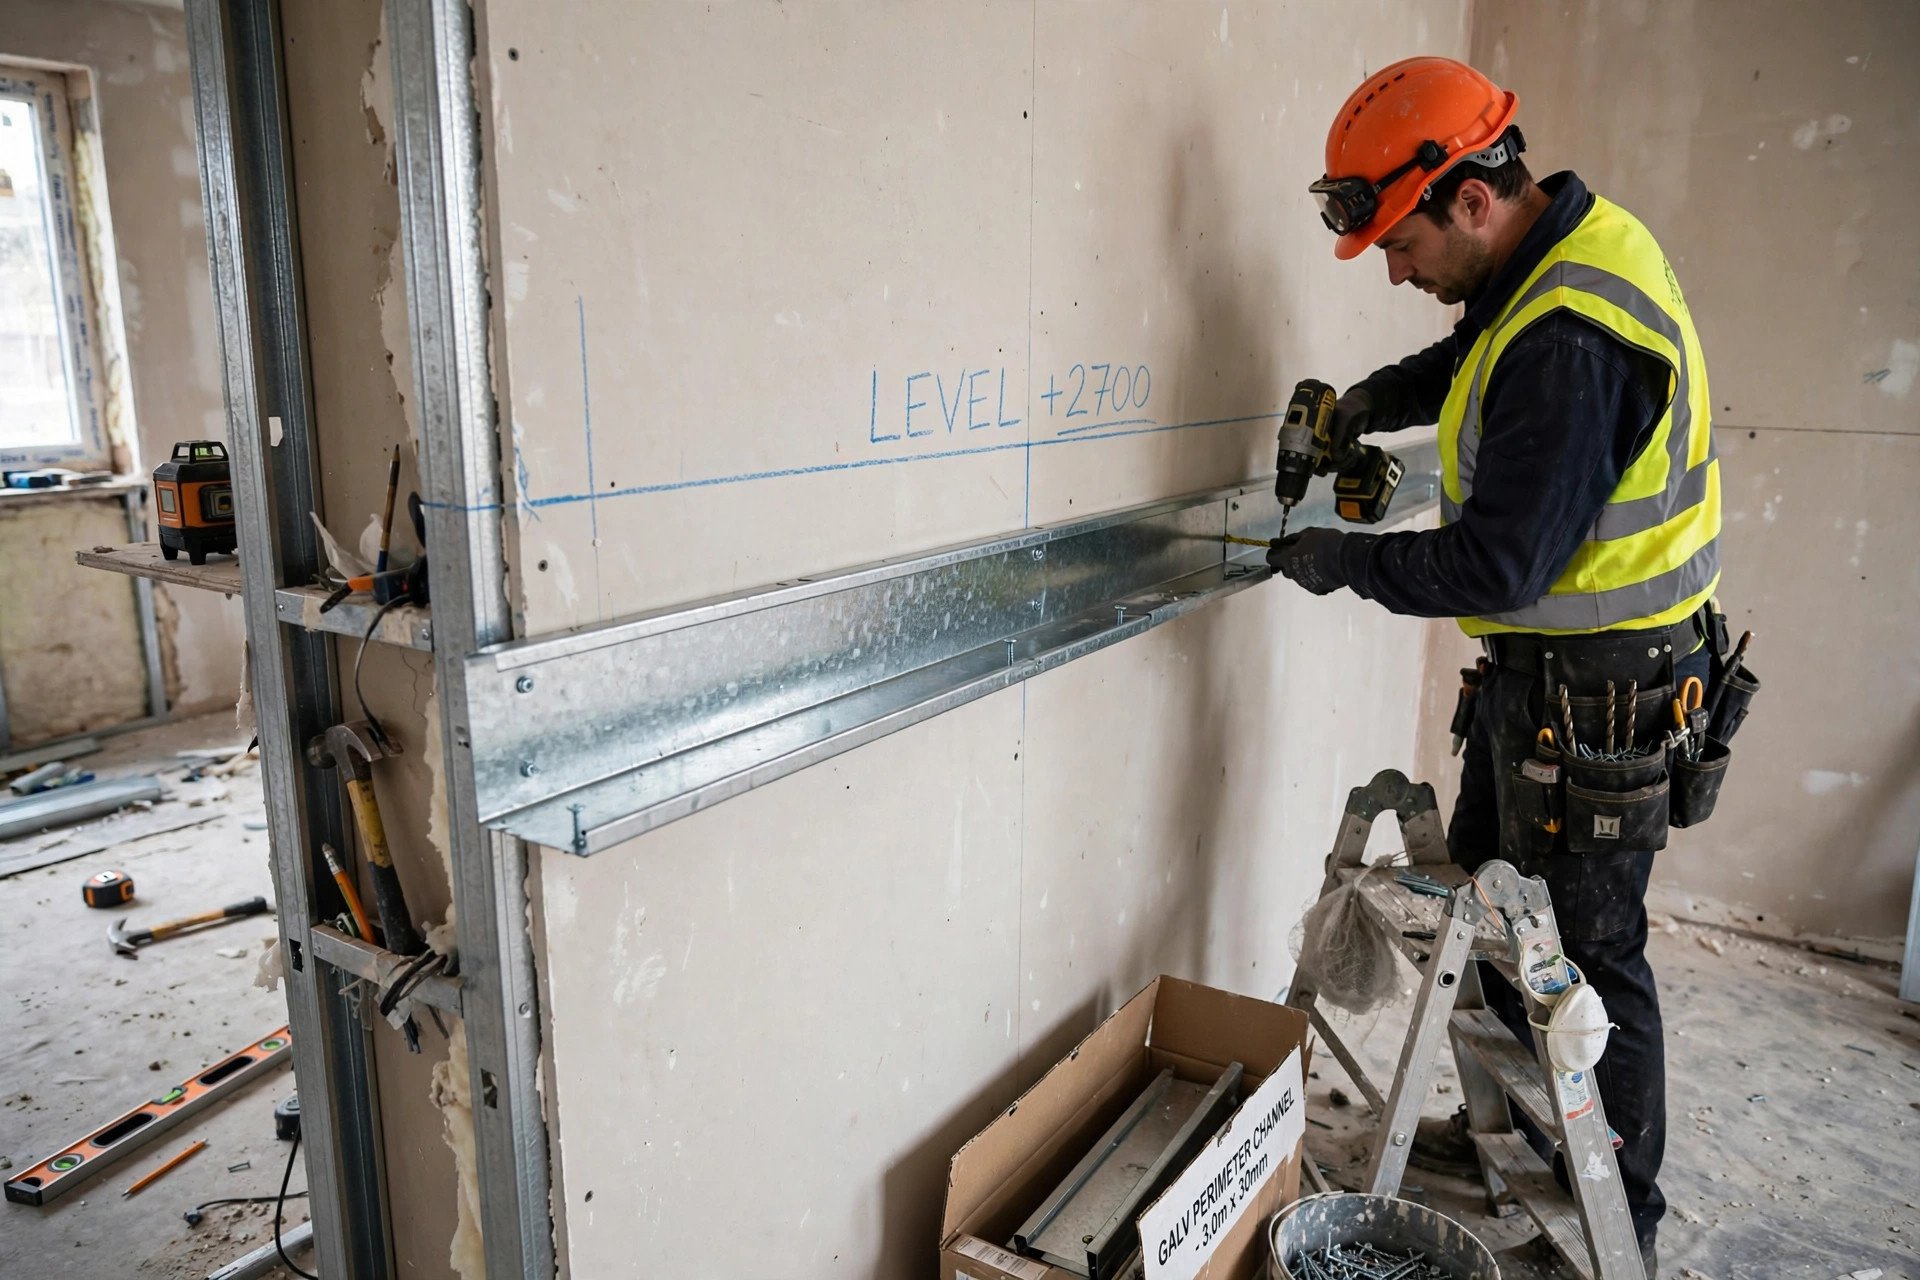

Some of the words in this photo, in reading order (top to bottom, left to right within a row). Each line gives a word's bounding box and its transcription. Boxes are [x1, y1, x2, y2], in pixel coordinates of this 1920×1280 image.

[870, 367, 1022, 443] LEVEL
[1041, 364, 1151, 418] +2700
[1158, 1209, 1190, 1266] GALV
[1192, 1138, 1252, 1226] PERIMETER
[1253, 1087, 1295, 1150] CHANNEL
[1202, 1204, 1228, 1247] 3.0m
[1229, 1192, 1237, 1213] x
[1238, 1153, 1268, 1201] 30mm
